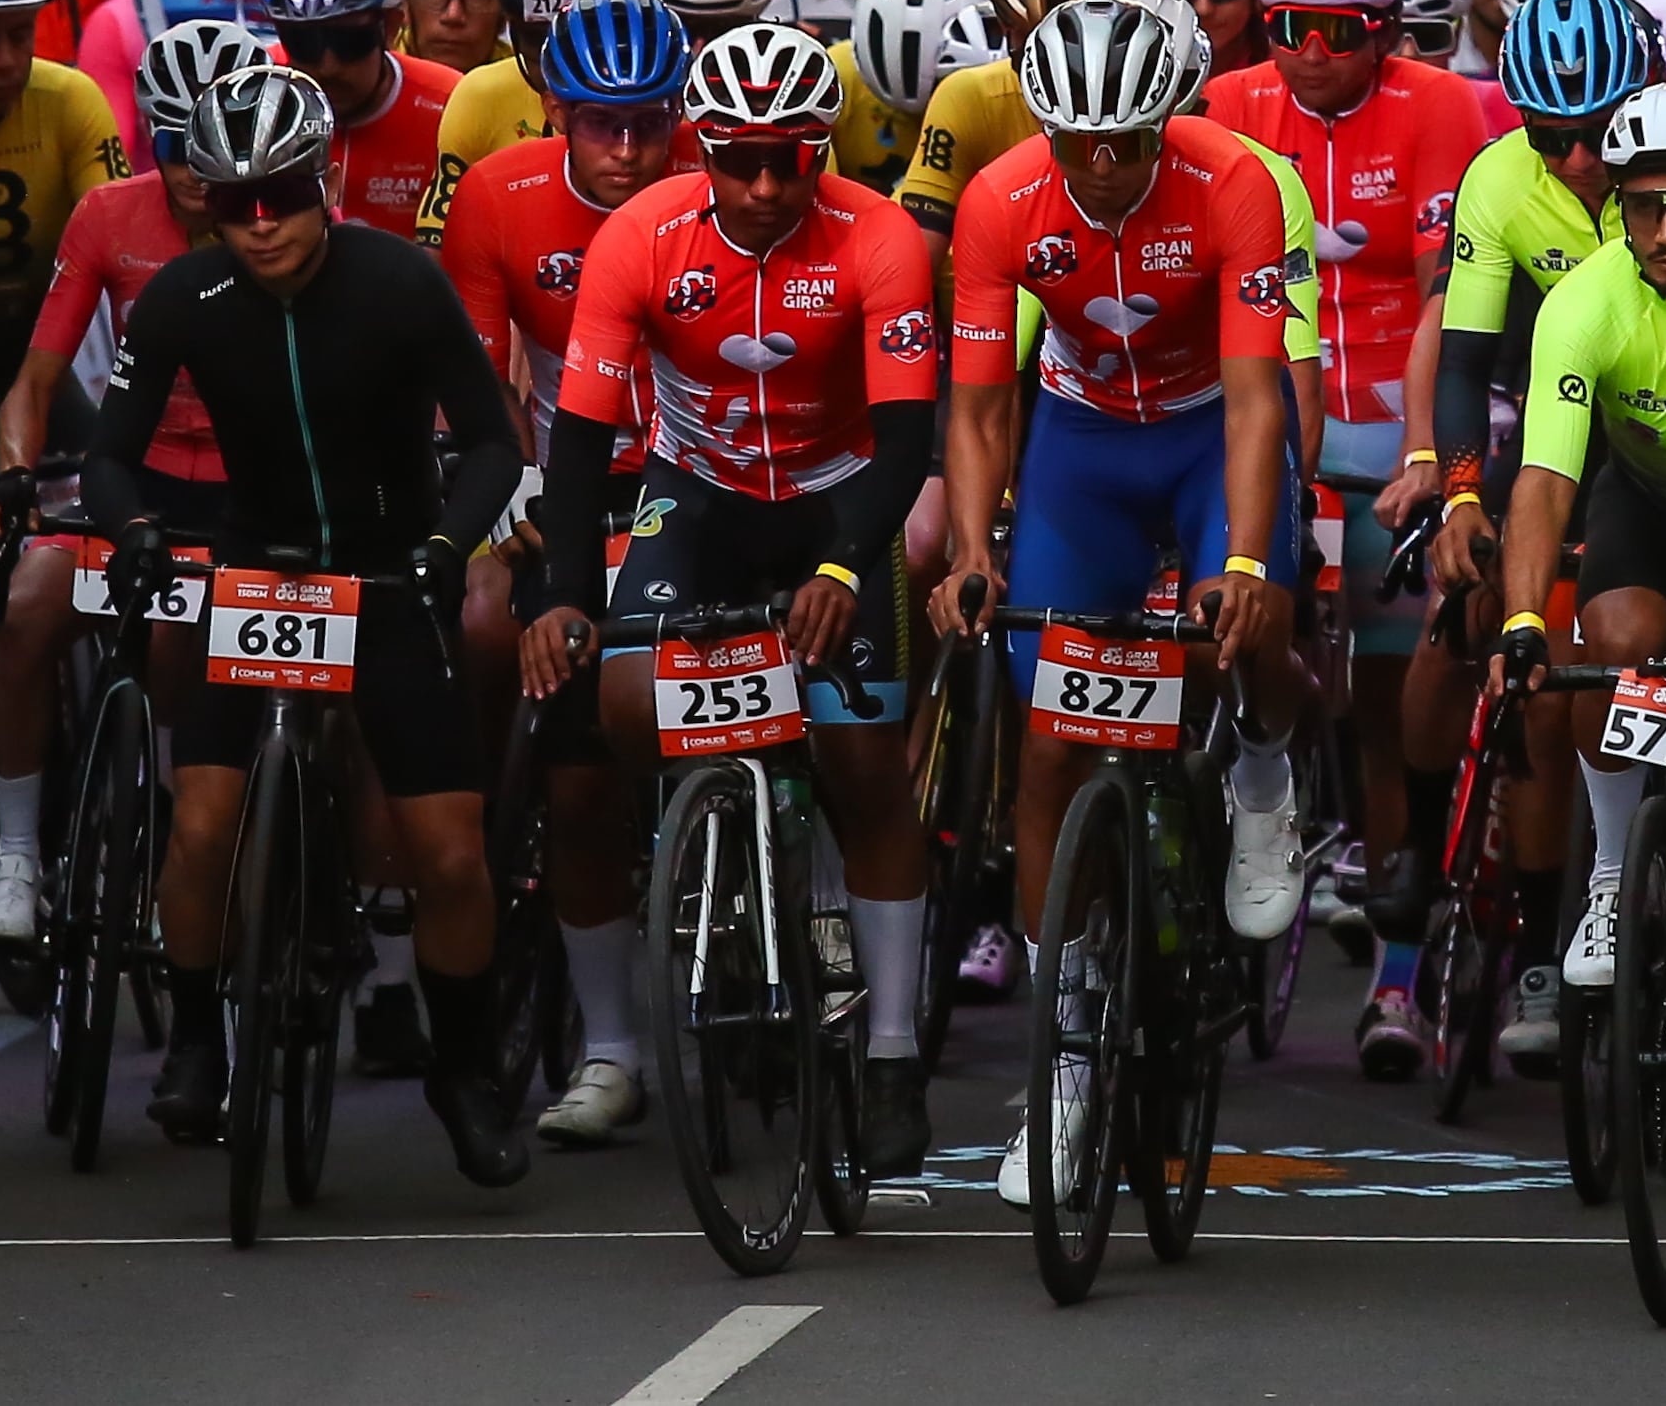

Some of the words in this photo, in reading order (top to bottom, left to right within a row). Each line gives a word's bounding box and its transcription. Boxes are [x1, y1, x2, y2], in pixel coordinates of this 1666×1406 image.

[368, 177, 423, 195] GRAN
[1141, 240, 1193, 258] GRAN
[1141, 256, 1184, 271] GIRO
[782, 279, 836, 295] GRAN
[782, 295, 825, 310] GIRO
[962, 329, 1006, 341] cuida
[299, 585, 333, 596] GRAN
[236, 612, 329, 661] 681
[730, 641, 763, 656] GRAN
[1125, 650, 1160, 661] GRAN
[678, 674, 773, 725] 253
[1059, 670, 1158, 720] 827
